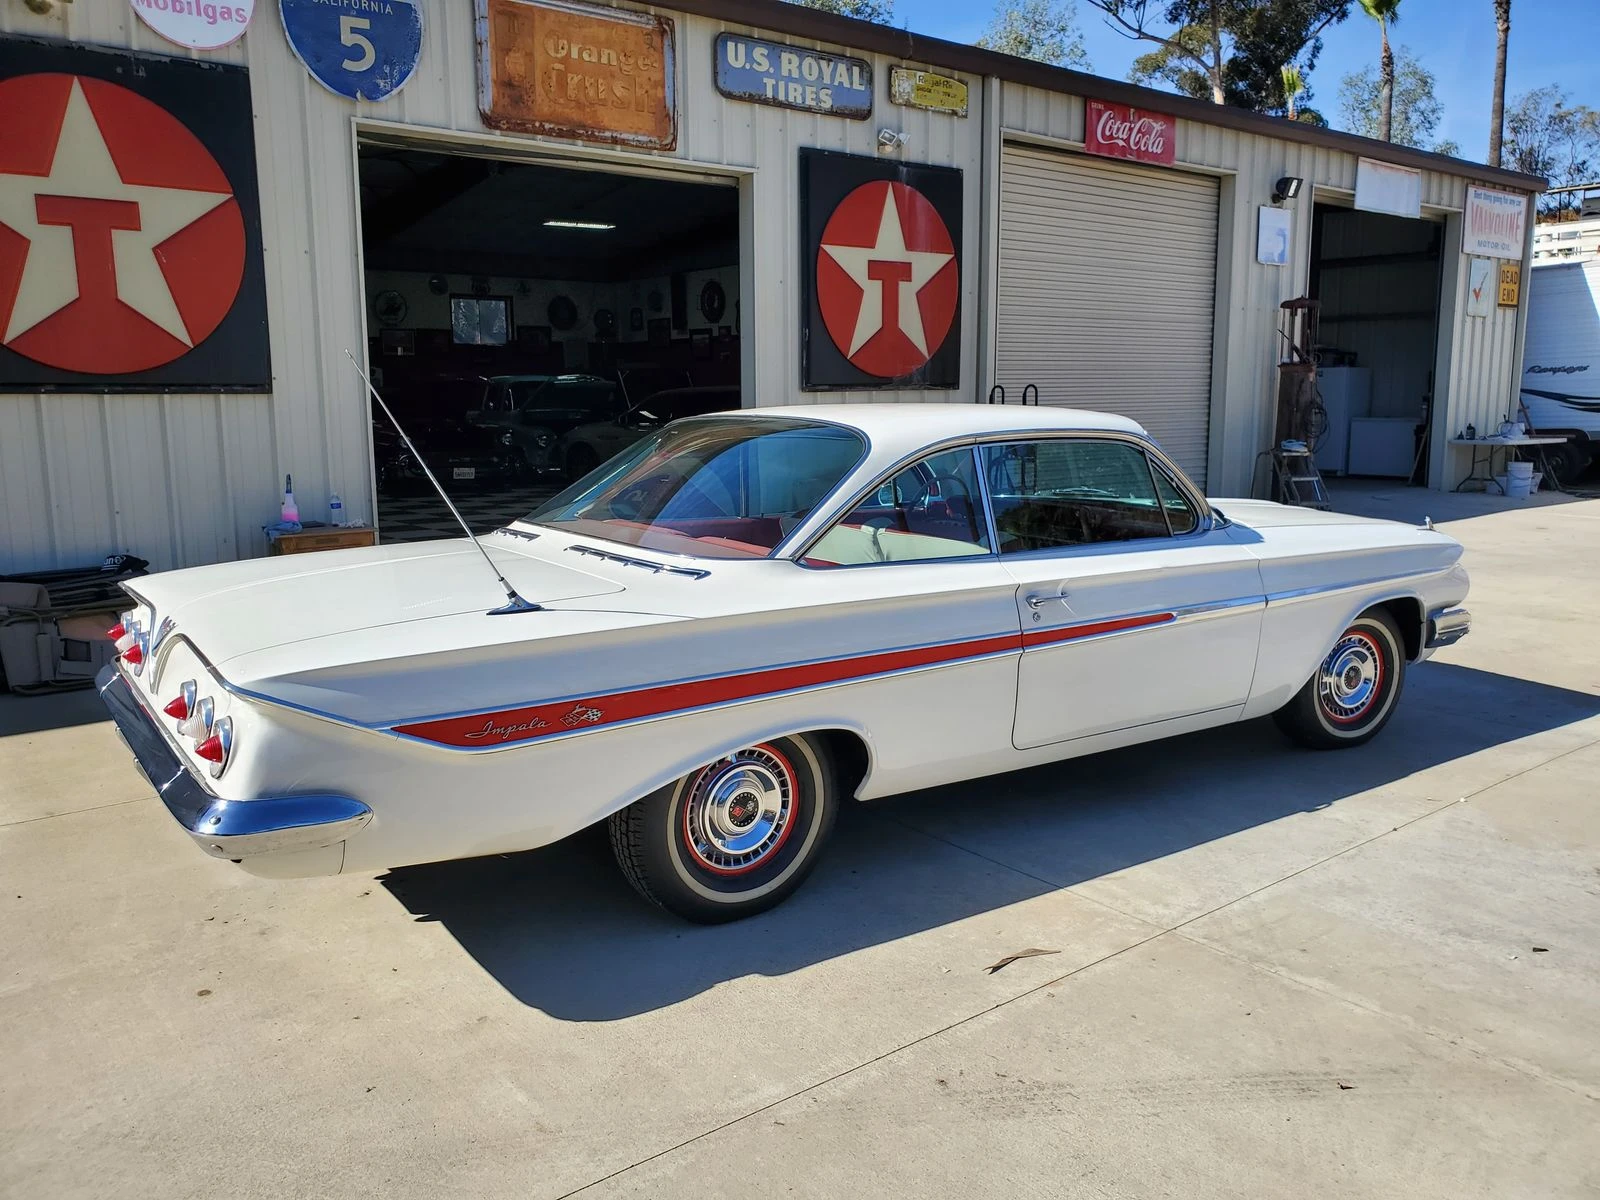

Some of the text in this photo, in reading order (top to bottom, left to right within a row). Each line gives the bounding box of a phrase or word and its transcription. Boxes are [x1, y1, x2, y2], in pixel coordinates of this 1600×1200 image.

[340, 15, 376, 72] 5
[727, 41, 865, 91] U.S. ROYAL
[763, 77, 833, 109] TIRES
[1097, 110, 1167, 154] Coca-Cola
[1501, 270, 1519, 285] DEAD
[1502, 287, 1515, 302] END
[464, 717, 552, 739] Impala
